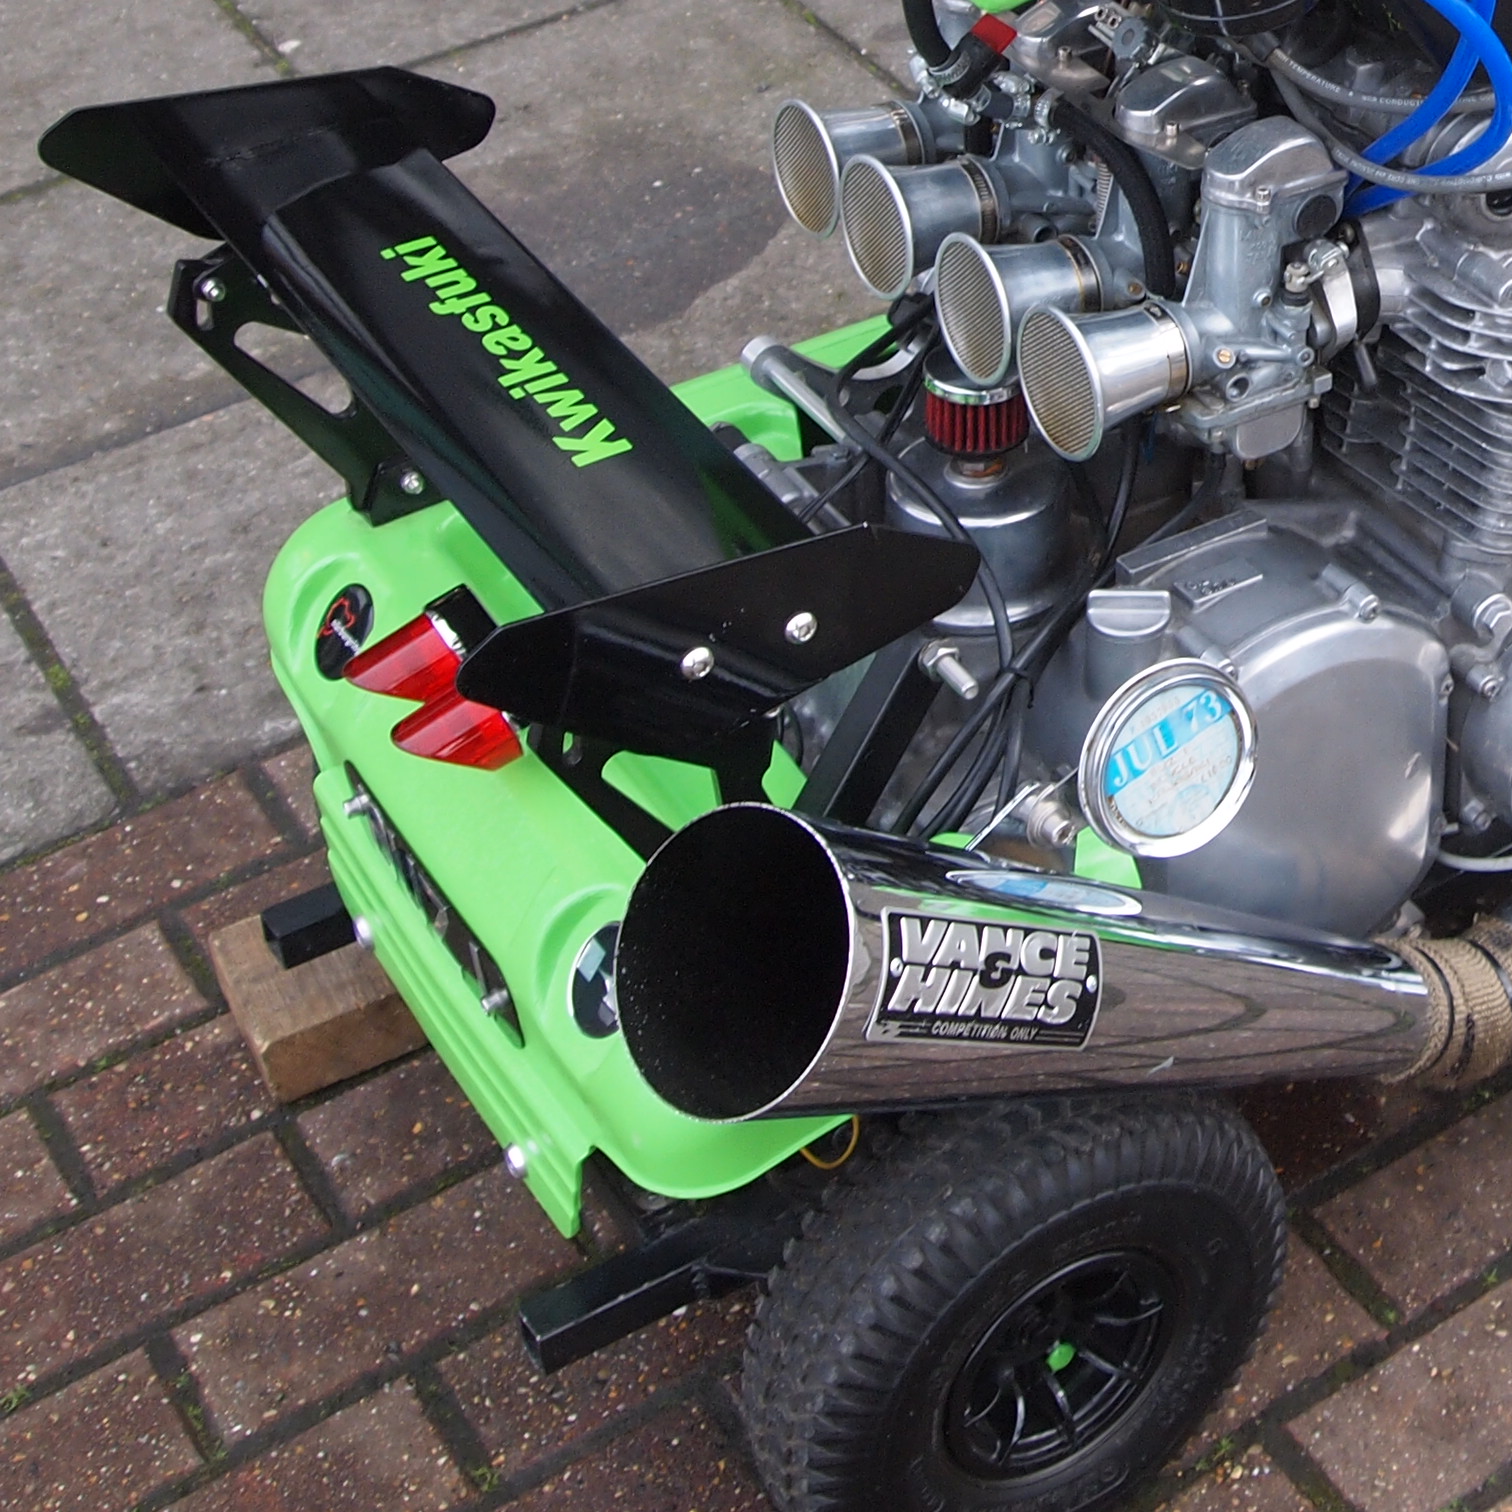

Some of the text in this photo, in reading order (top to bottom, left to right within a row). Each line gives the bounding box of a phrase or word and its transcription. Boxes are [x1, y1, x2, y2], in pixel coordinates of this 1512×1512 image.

[379, 235, 634, 468] Kwikasfuki
[1112, 716, 1180, 789] JUL
[1181, 689, 1224, 733] 73
[900, 916, 1092, 981] VANCE
[887, 964, 1084, 1025] HINES
[931, 1020, 1039, 1042] COMPETITION ONLY
